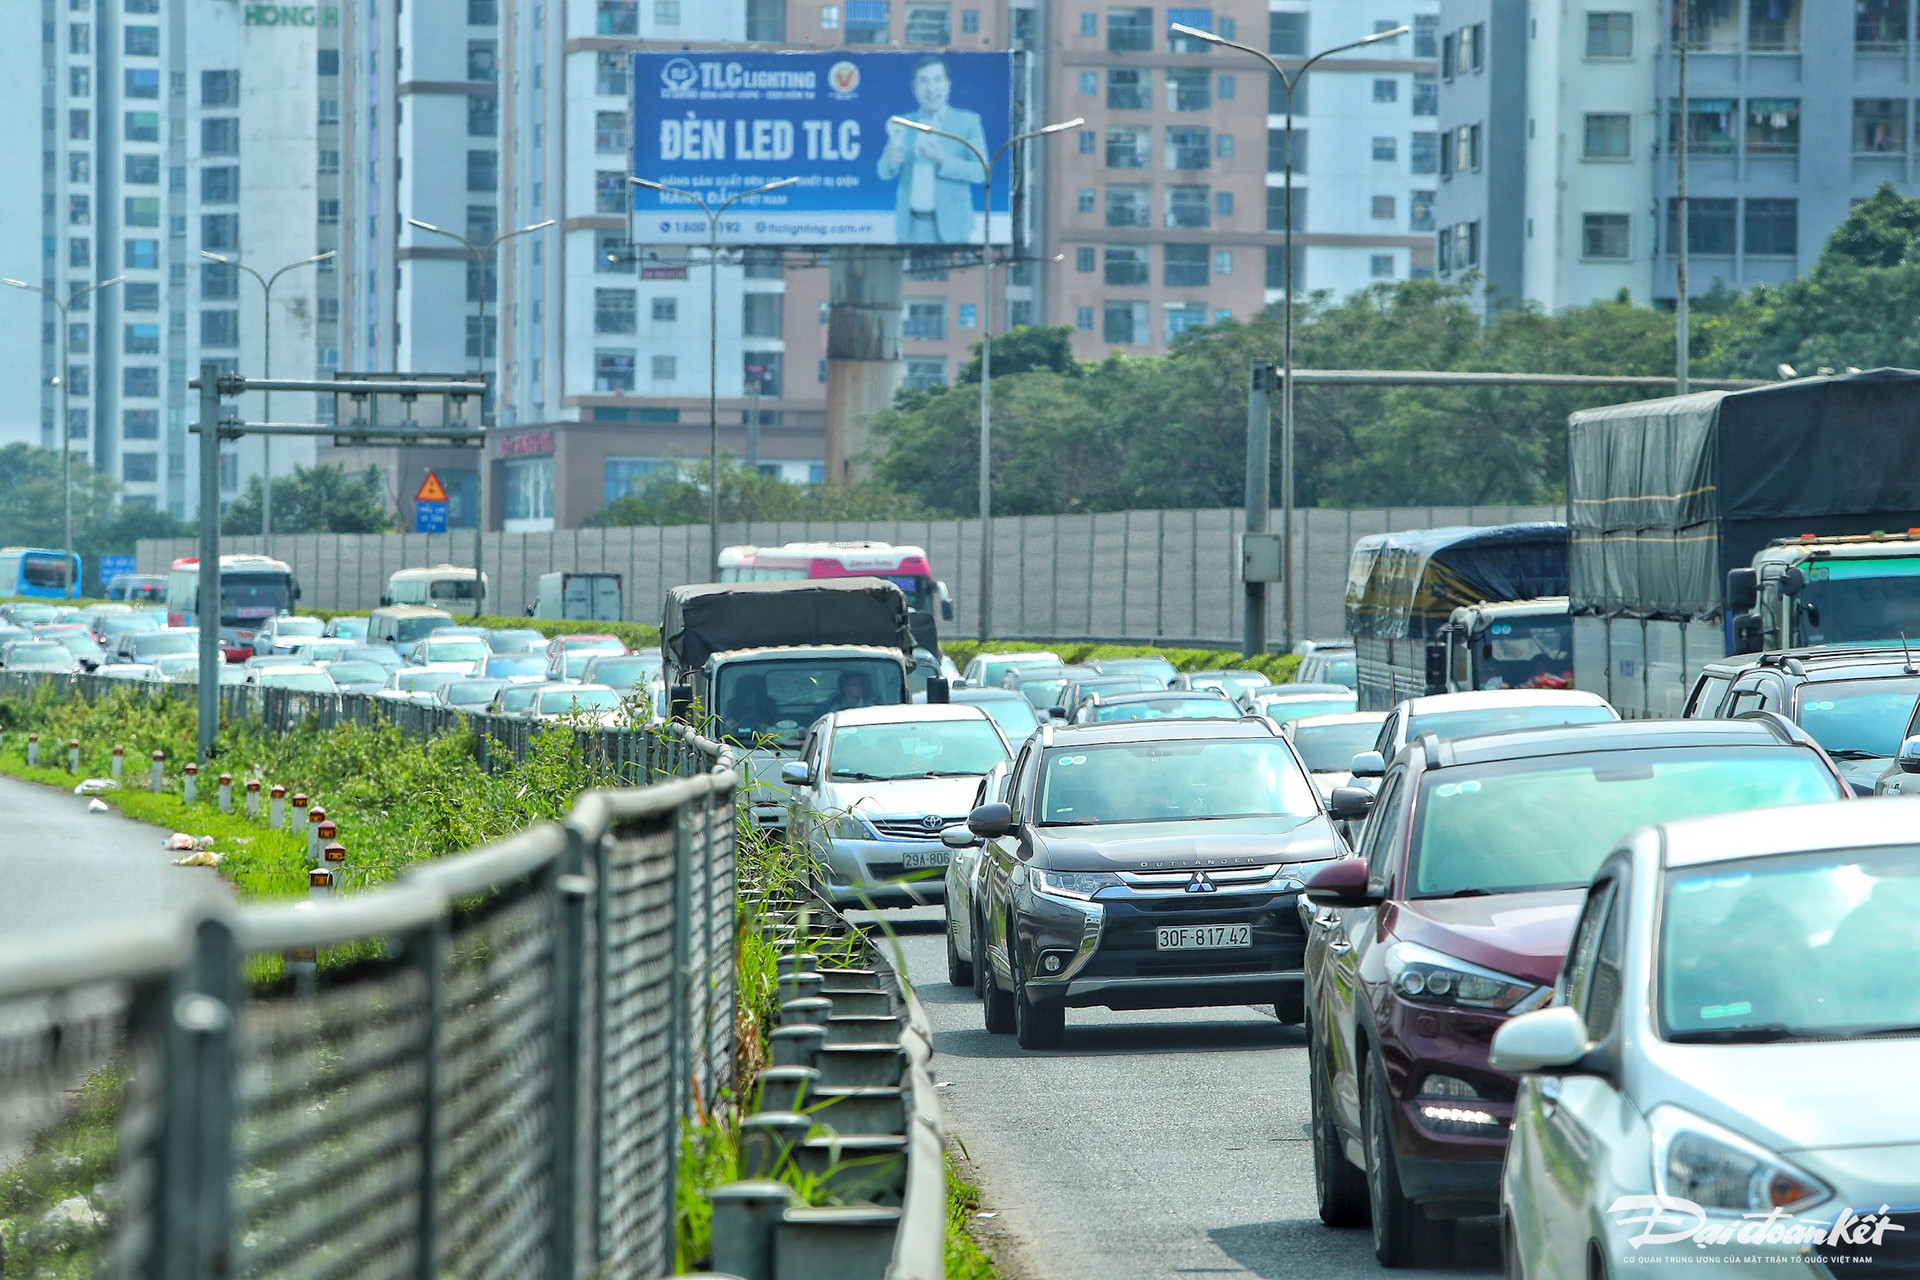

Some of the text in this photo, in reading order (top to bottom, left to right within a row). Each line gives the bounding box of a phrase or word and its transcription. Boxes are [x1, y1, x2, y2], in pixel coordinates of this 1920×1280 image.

[660, 110, 861, 160] ĐÈN LED TLC
[1141, 857, 1255, 867] OUTLANDER
[1160, 927, 1249, 947] 30F-817.42
